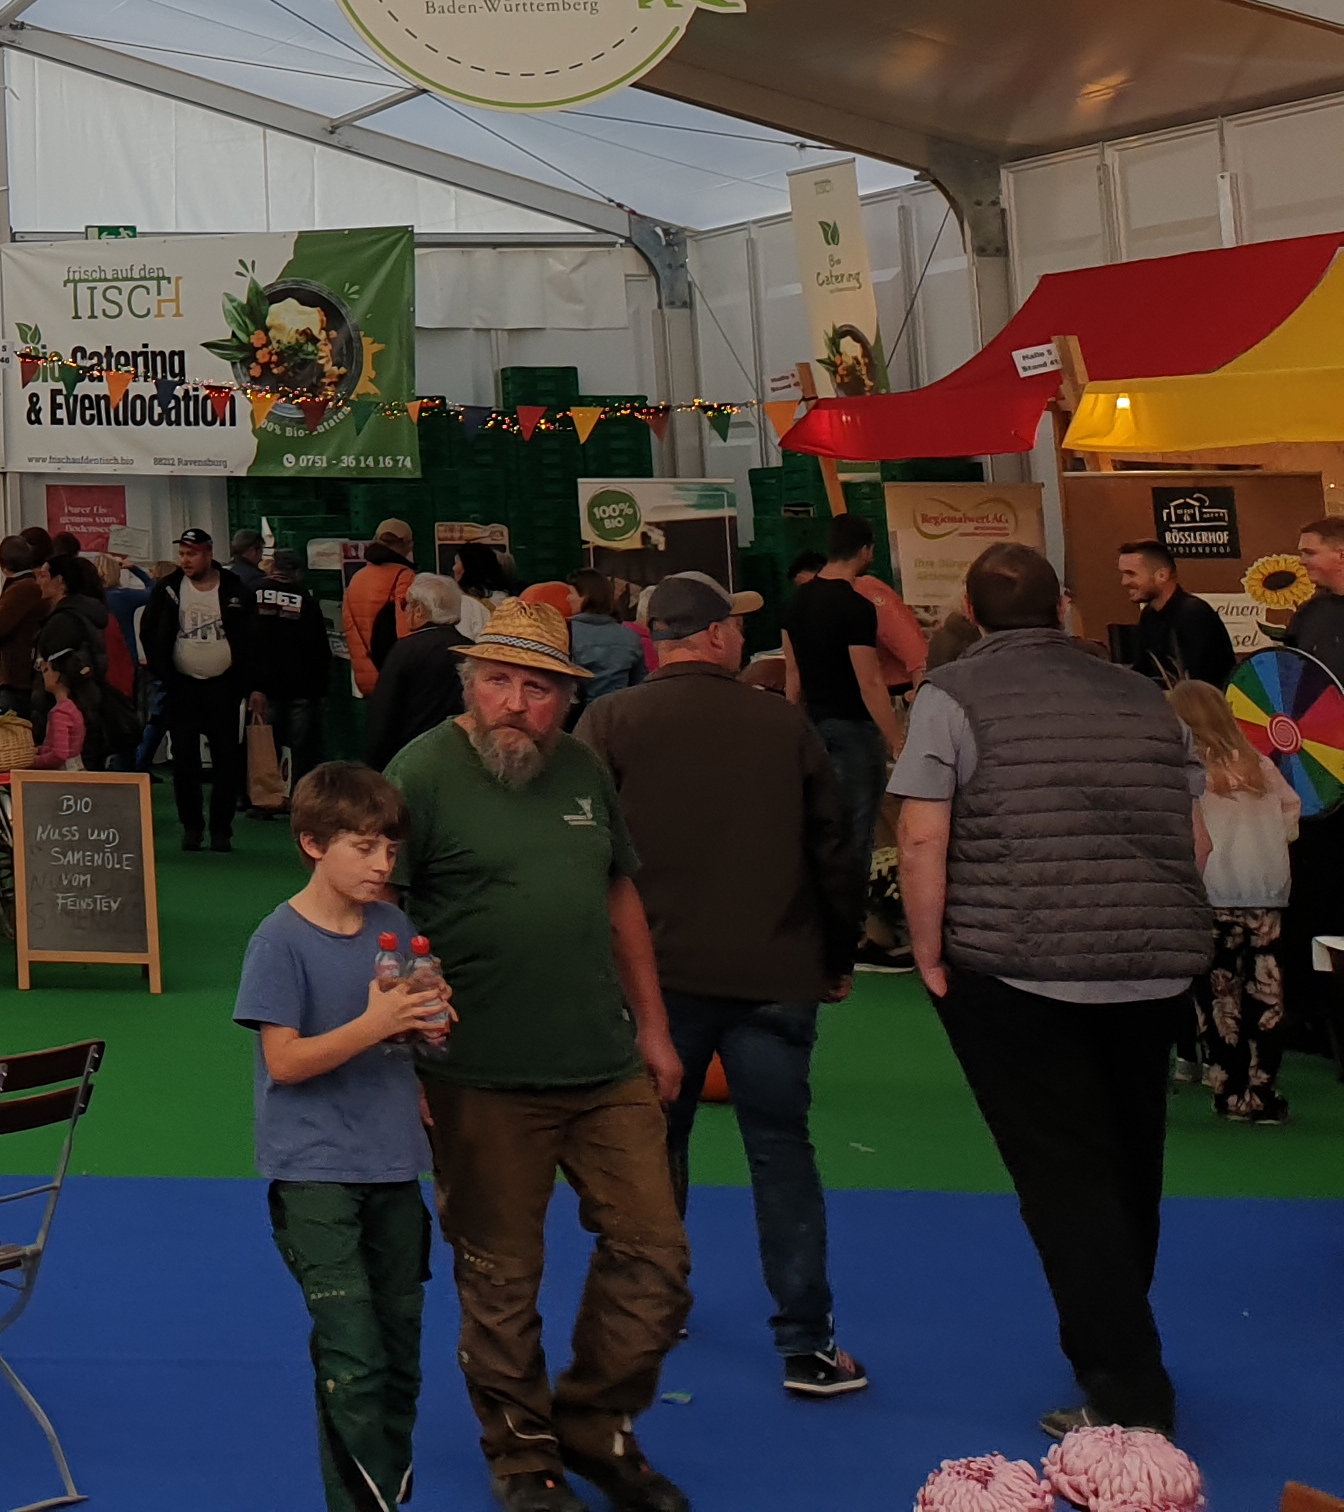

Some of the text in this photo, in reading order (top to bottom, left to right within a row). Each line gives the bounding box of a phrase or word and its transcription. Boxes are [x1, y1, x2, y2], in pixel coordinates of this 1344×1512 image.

[66, 264, 165, 280] frisch auf den
[63, 276, 184, 320] TISCH
[1, 343, 7, 352] 5
[70, 343, 185, 383] Catering
[26, 392, 43, 426] &
[299, 455, 327, 468] 0751
[340, 455, 356, 468] 36
[359, 455, 375, 468] 14
[378, 455, 394, 468] 16
[396, 455, 413, 468] 74
[592, 501, 634, 520] 100%
[1165, 528, 1230, 545] RÖSSLERHOF
[255, 589, 303, 608] 1963
